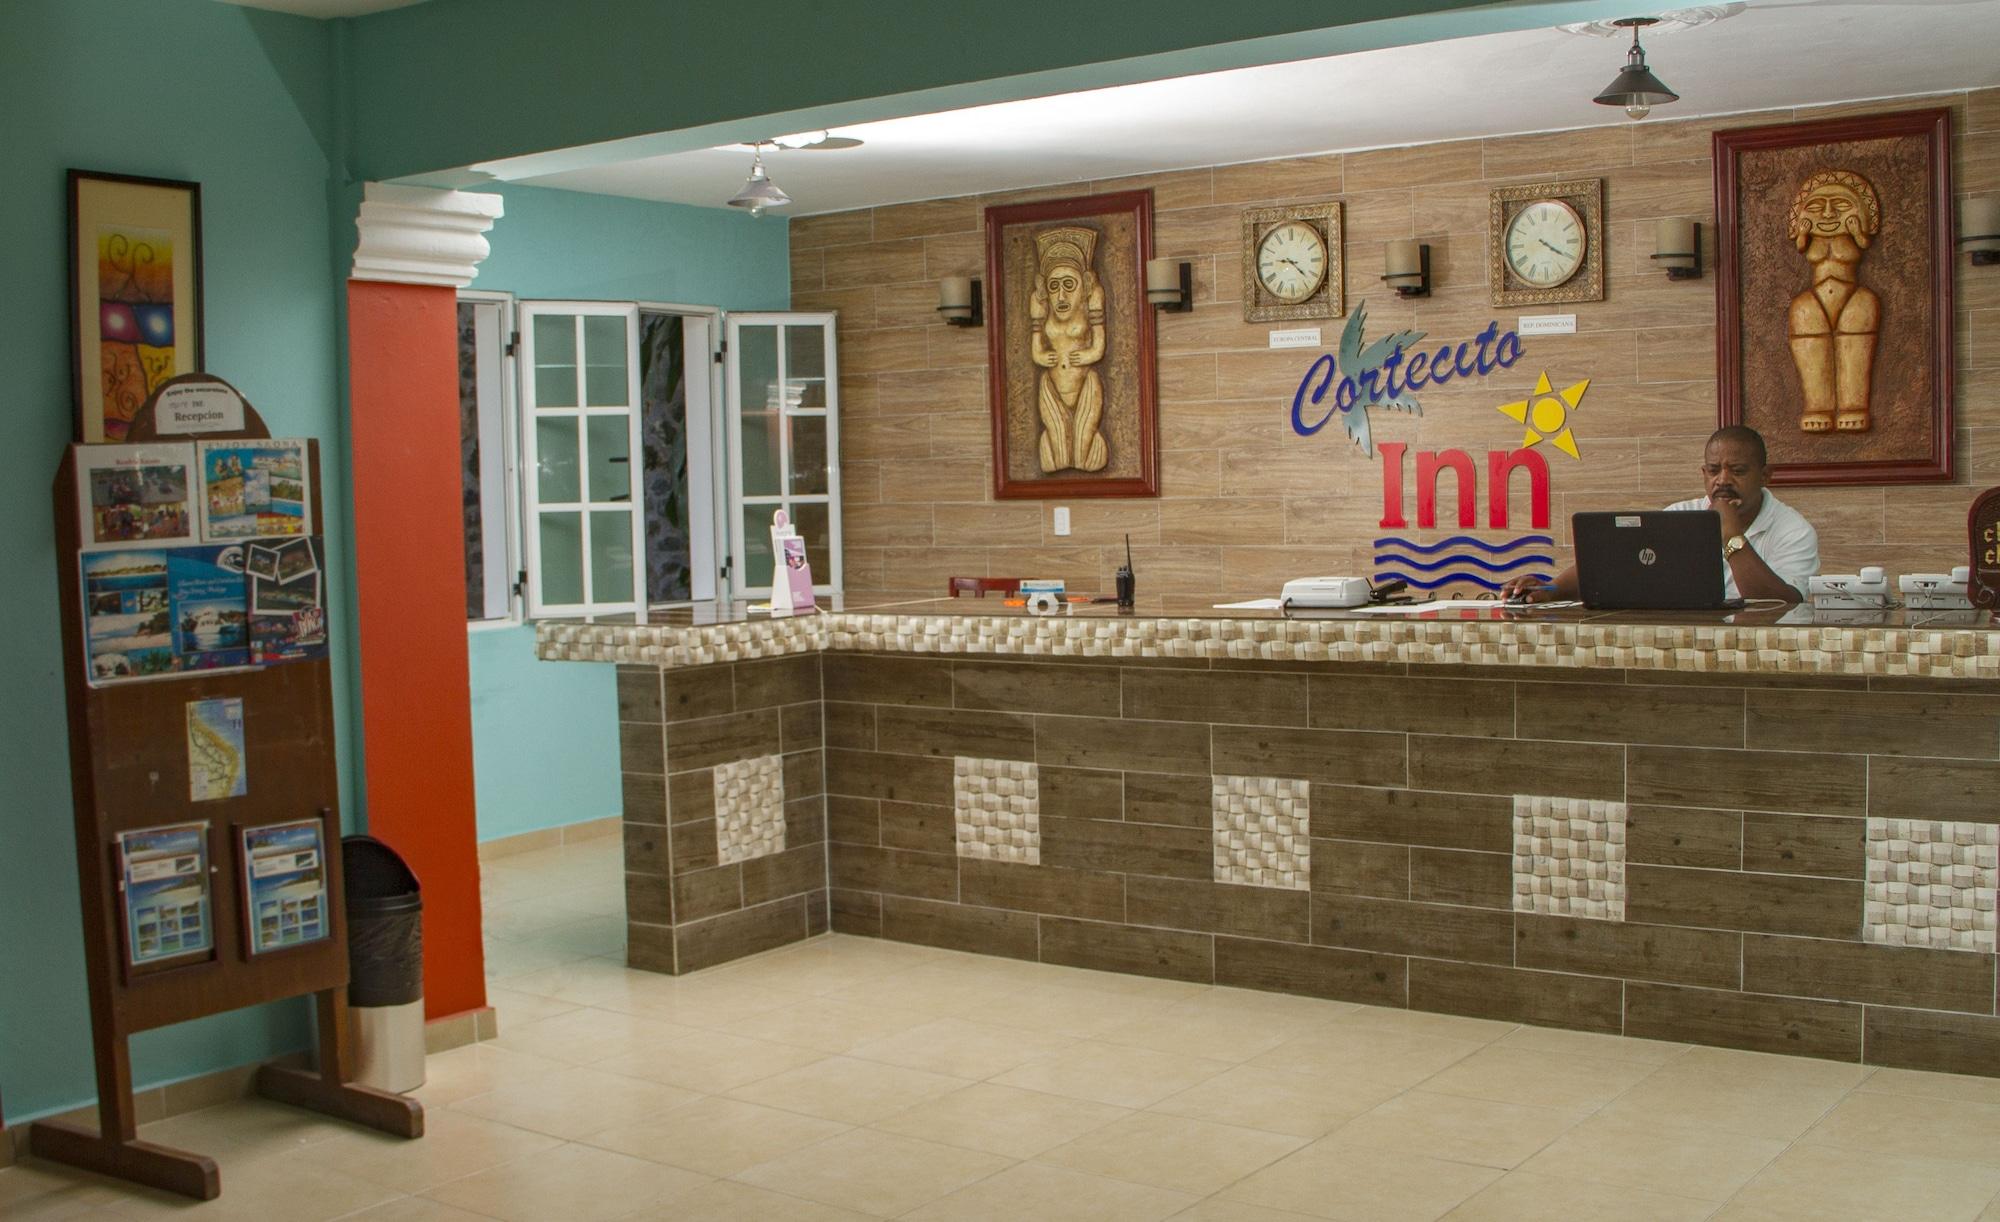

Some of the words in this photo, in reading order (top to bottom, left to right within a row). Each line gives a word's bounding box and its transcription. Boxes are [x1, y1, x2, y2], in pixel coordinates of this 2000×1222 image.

[1535, 320, 1573, 328] DOMINICANA
[1291, 320, 1526, 437] Cortecito
[166, 388, 184, 397] Enjoy
[207, 441, 249, 449] ENJOY
[1377, 442, 1550, 529] Inn
[1640, 548, 1655, 566] hp
